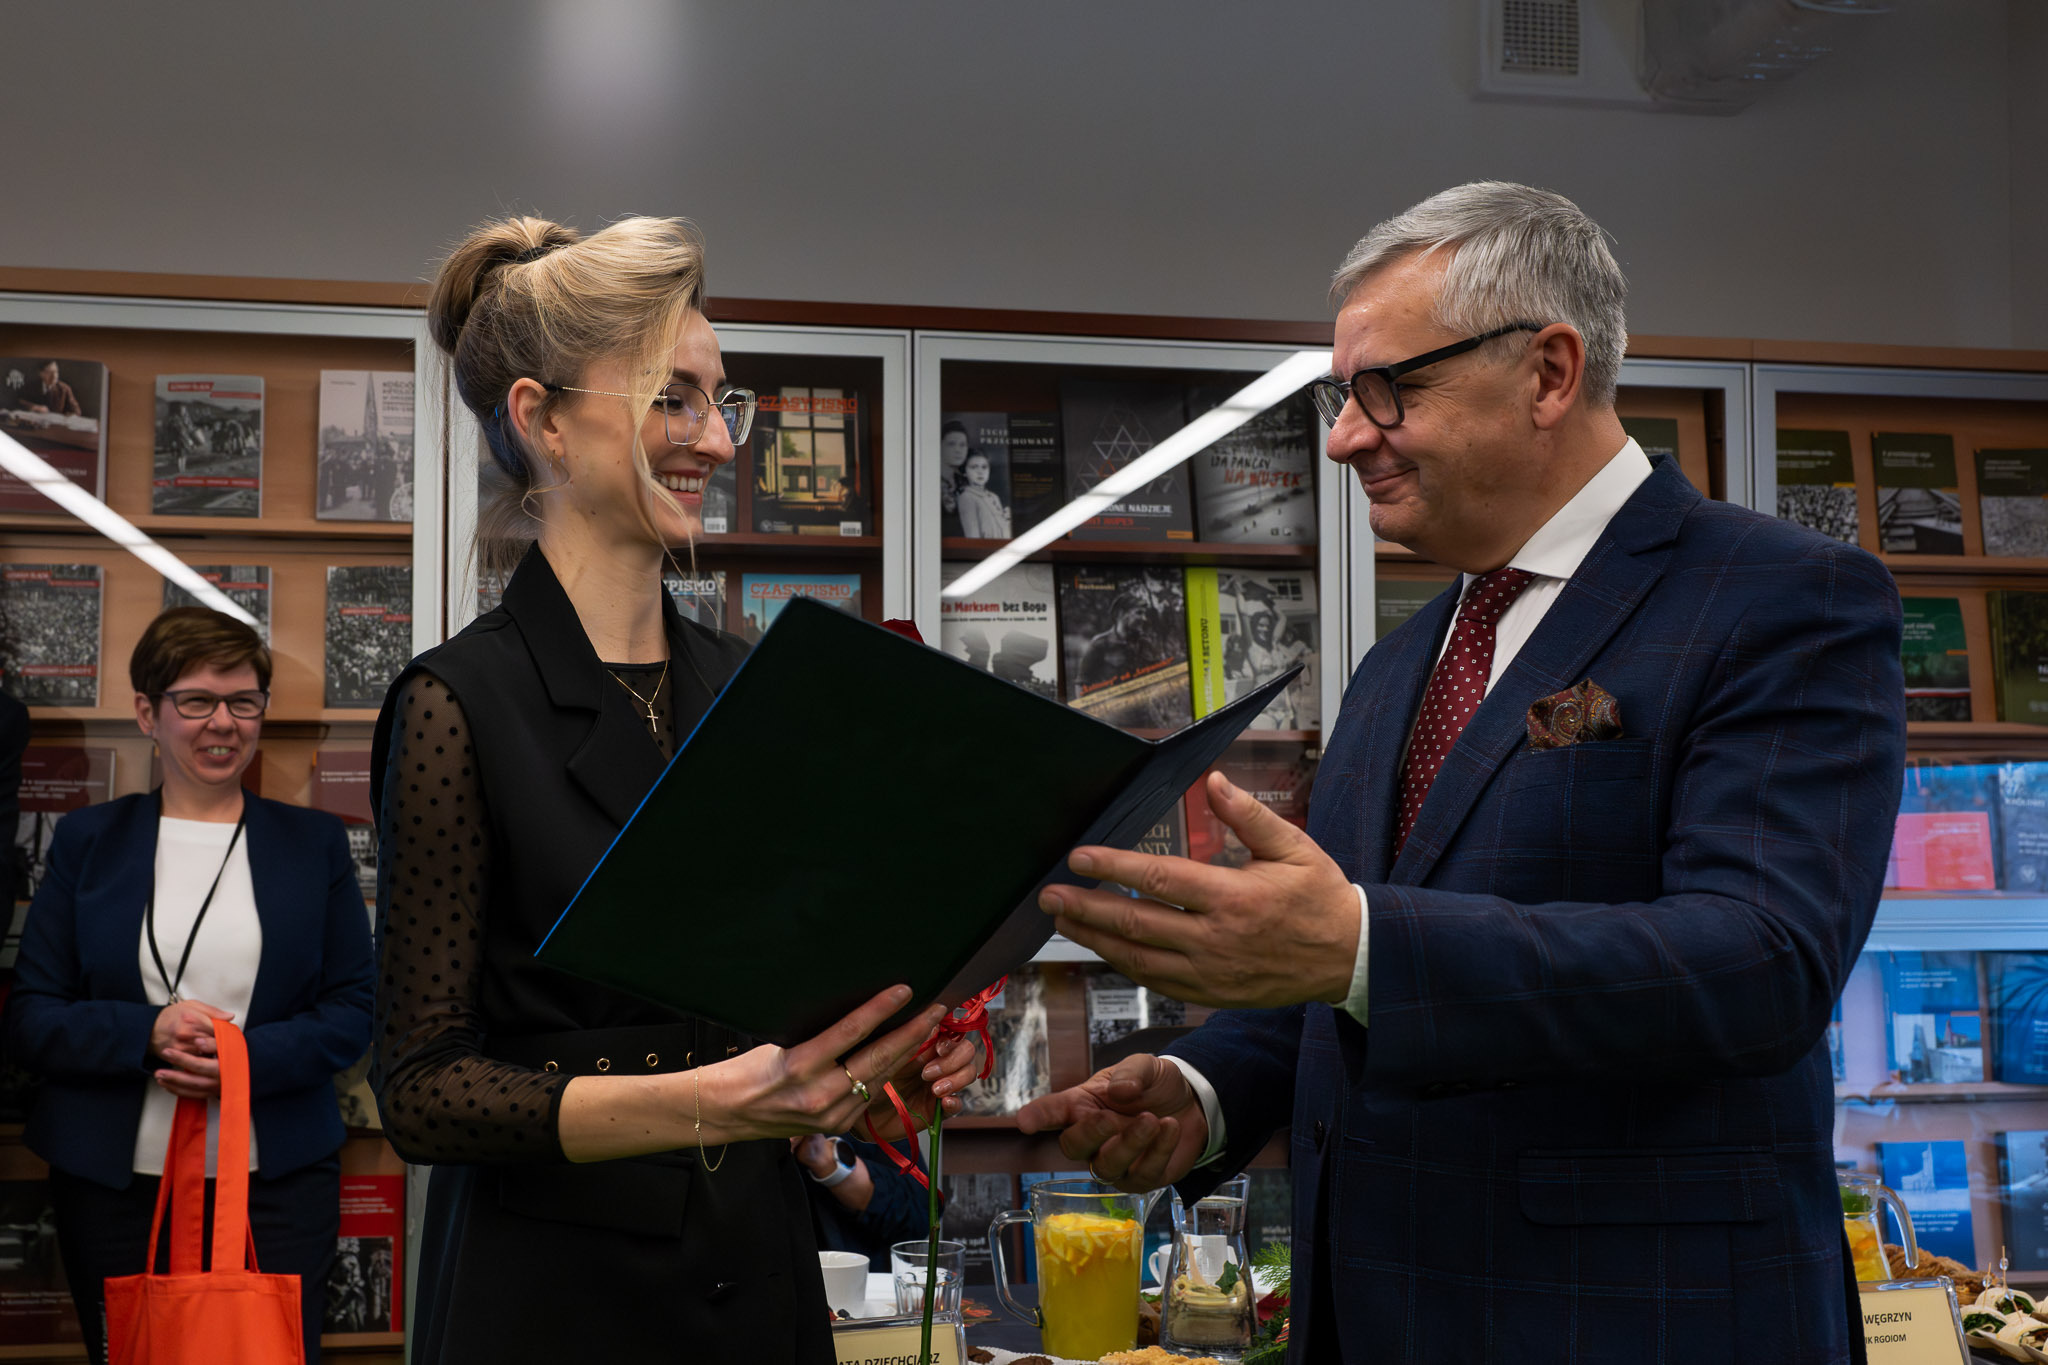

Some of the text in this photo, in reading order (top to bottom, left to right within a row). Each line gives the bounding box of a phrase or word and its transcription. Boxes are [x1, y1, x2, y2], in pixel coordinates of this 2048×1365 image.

[758, 396, 858, 411] CZASYPISMO
[980, 437, 1055, 445] PRZECHOWANE
[1128, 503, 1171, 514] NADZIEJE
[751, 583, 851, 597] CZASYPISMO
[954, 601, 1001, 613] Marksem
[1003, 602, 1020, 613] bez
[1022, 602, 1047, 614] Boga
[1200, 617, 1211, 657] BETONU
[1864, 1312, 1912, 1326] WĘGRZYN
[1874, 1333, 1906, 1344] RGOIOM
